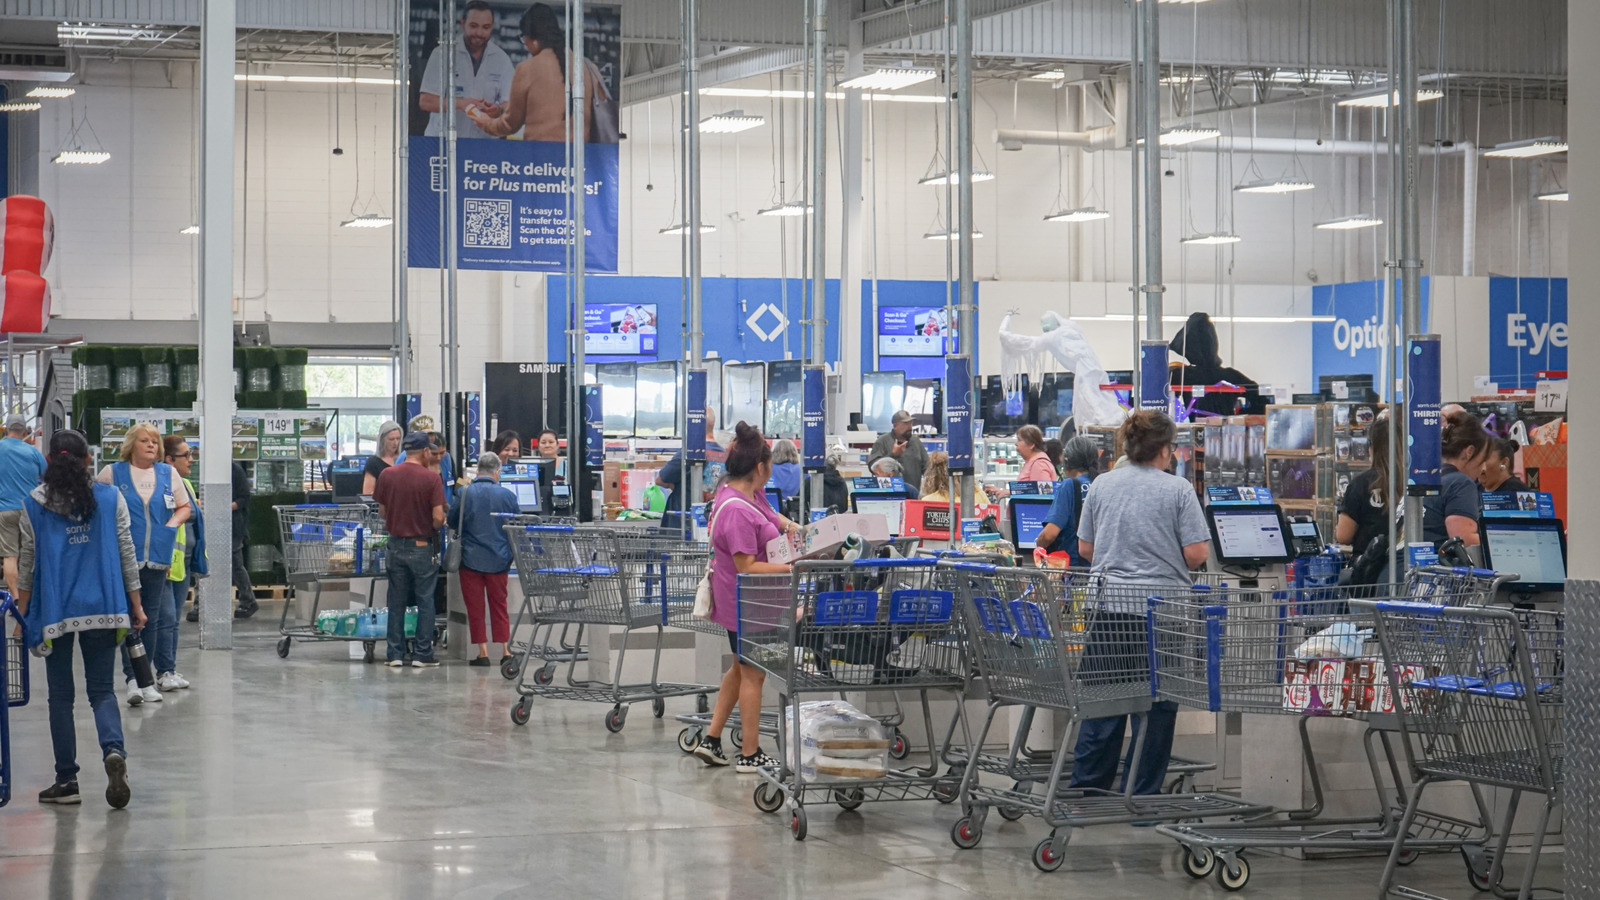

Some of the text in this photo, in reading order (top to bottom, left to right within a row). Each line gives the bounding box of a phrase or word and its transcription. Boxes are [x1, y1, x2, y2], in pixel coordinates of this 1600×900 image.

[464, 160, 498, 174] Free
[501, 161, 521, 175] Rx
[464, 177, 486, 190] for
[489, 178, 520, 192] Plus
[520, 206, 563, 217] It's easy to
[520, 217, 552, 225] transfer
[520, 226, 540, 234] Scan
[541, 227, 555, 235] the
[520, 236, 528, 244] to
[530, 237, 544, 246] get
[1507, 313, 1568, 355] Eye
[65, 522, 91, 534] sam's
[69, 533, 89, 545] club
